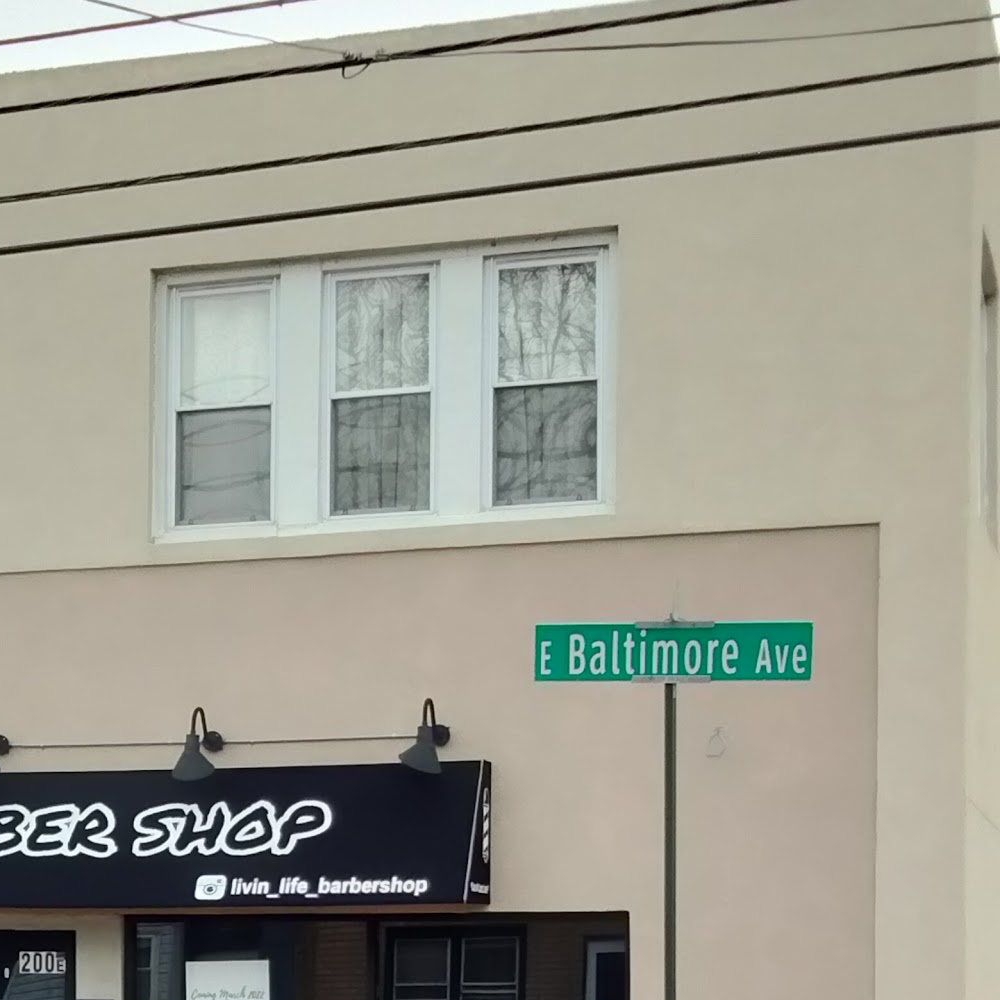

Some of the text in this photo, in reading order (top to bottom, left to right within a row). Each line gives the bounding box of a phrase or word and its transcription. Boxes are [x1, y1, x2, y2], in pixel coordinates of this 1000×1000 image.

[539, 629, 808, 676] E Baltimore Ave
[132, 799, 333, 857] SHOP
[229, 876, 429, 899] livin_life_barbershop
